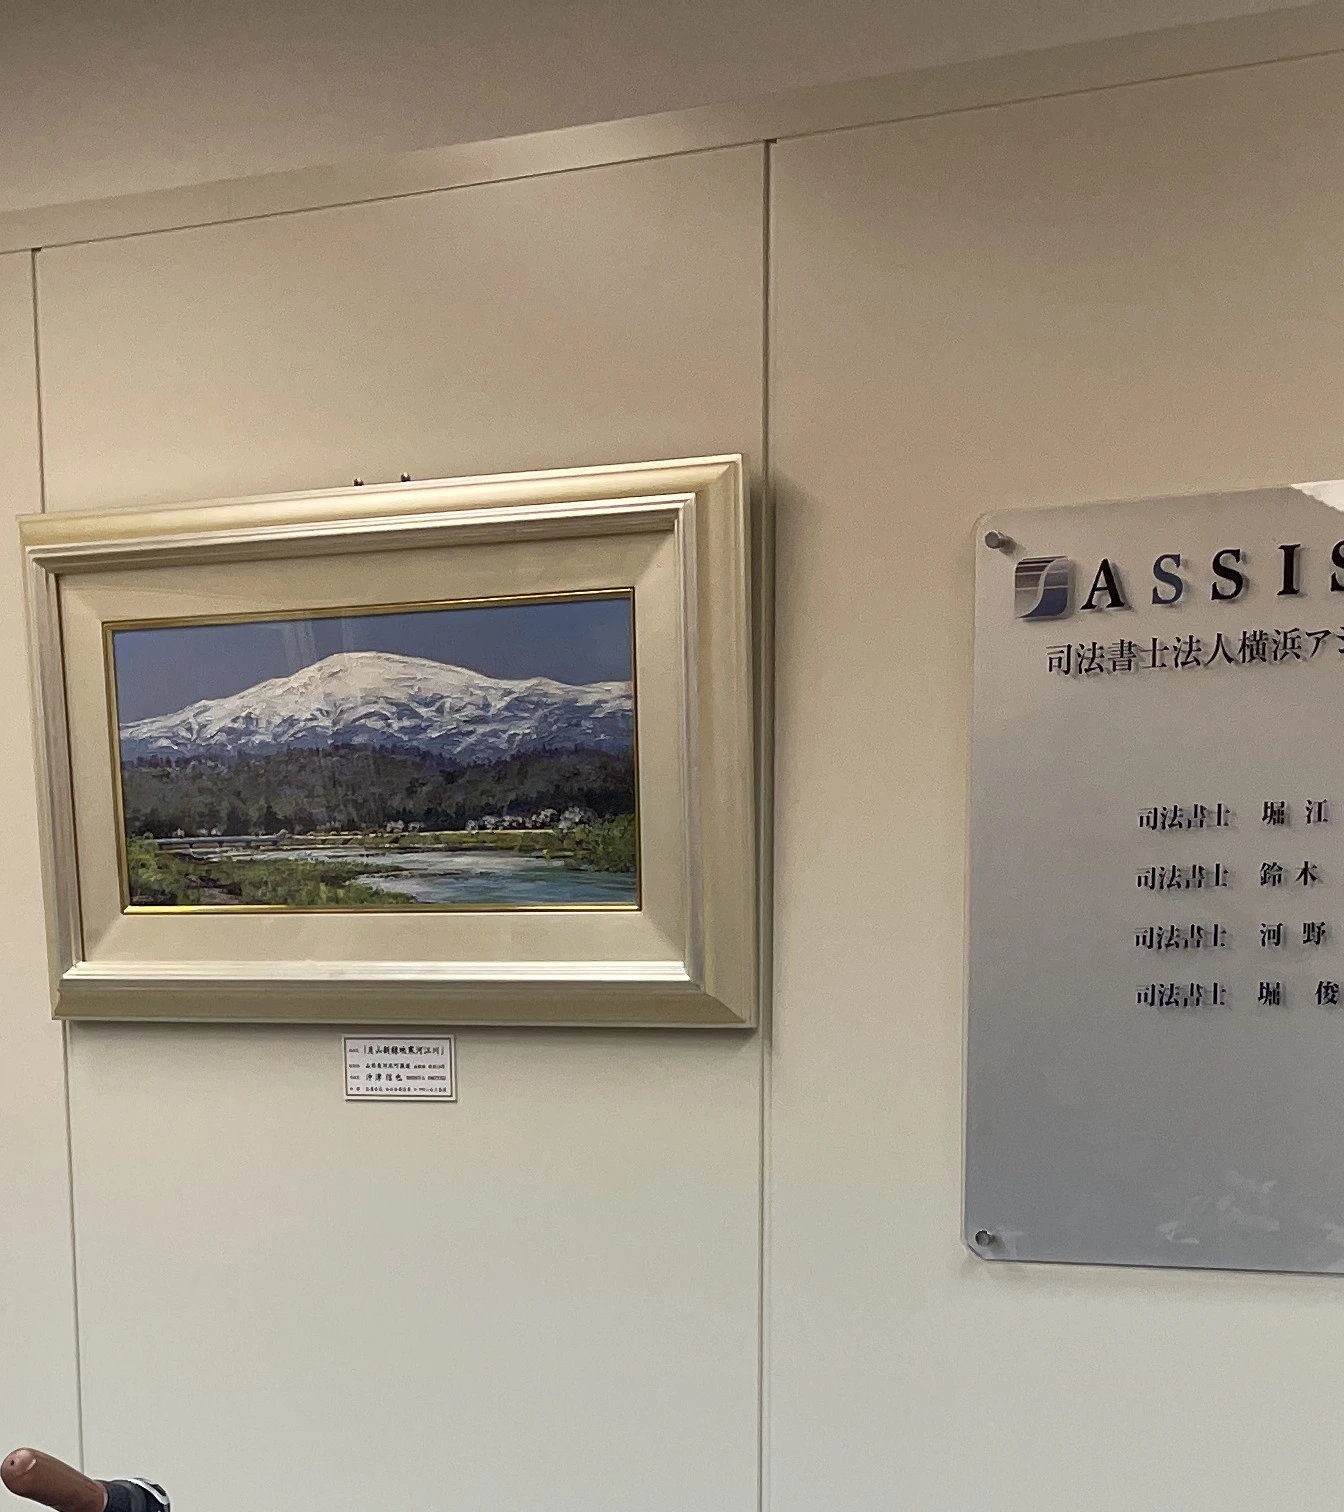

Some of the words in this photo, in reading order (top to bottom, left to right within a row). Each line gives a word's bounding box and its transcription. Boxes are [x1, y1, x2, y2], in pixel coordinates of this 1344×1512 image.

[1138, 803, 1231, 831] 司法書士
[1262, 799, 1329, 826] 堀江
[1136, 863, 1229, 890] 司法書士
[1259, 860, 1319, 887] 鈴木
[1134, 923, 1228, 950] 司法書士
[1259, 922, 1326, 947] 河野
[1136, 982, 1227, 1007] 司法書士
